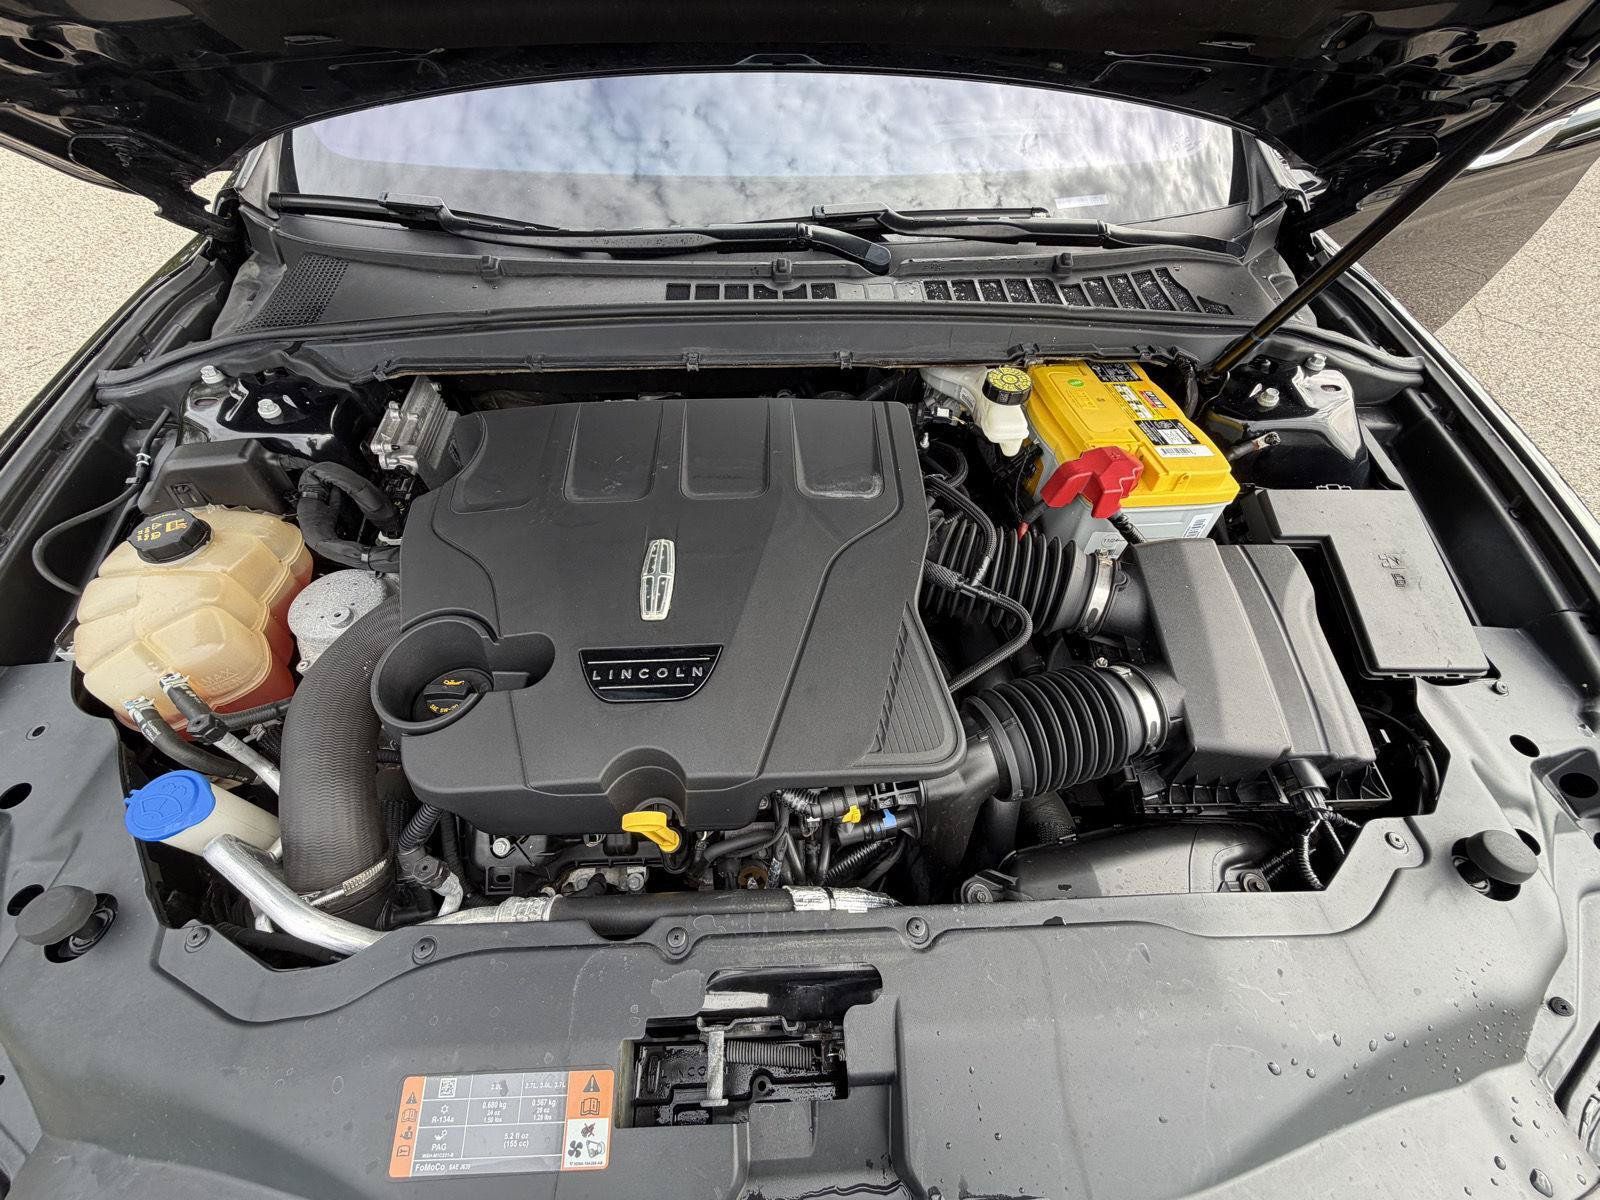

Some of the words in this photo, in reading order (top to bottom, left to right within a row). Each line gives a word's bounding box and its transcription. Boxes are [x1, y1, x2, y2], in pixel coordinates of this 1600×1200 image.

[593, 666, 703, 680] LINCOLN
[431, 1115, 455, 1124] R-134a
[504, 1132, 514, 1140] 5.2
[431, 1142, 447, 1151] PAG
[414, 1162, 446, 1171] FoMoCo
